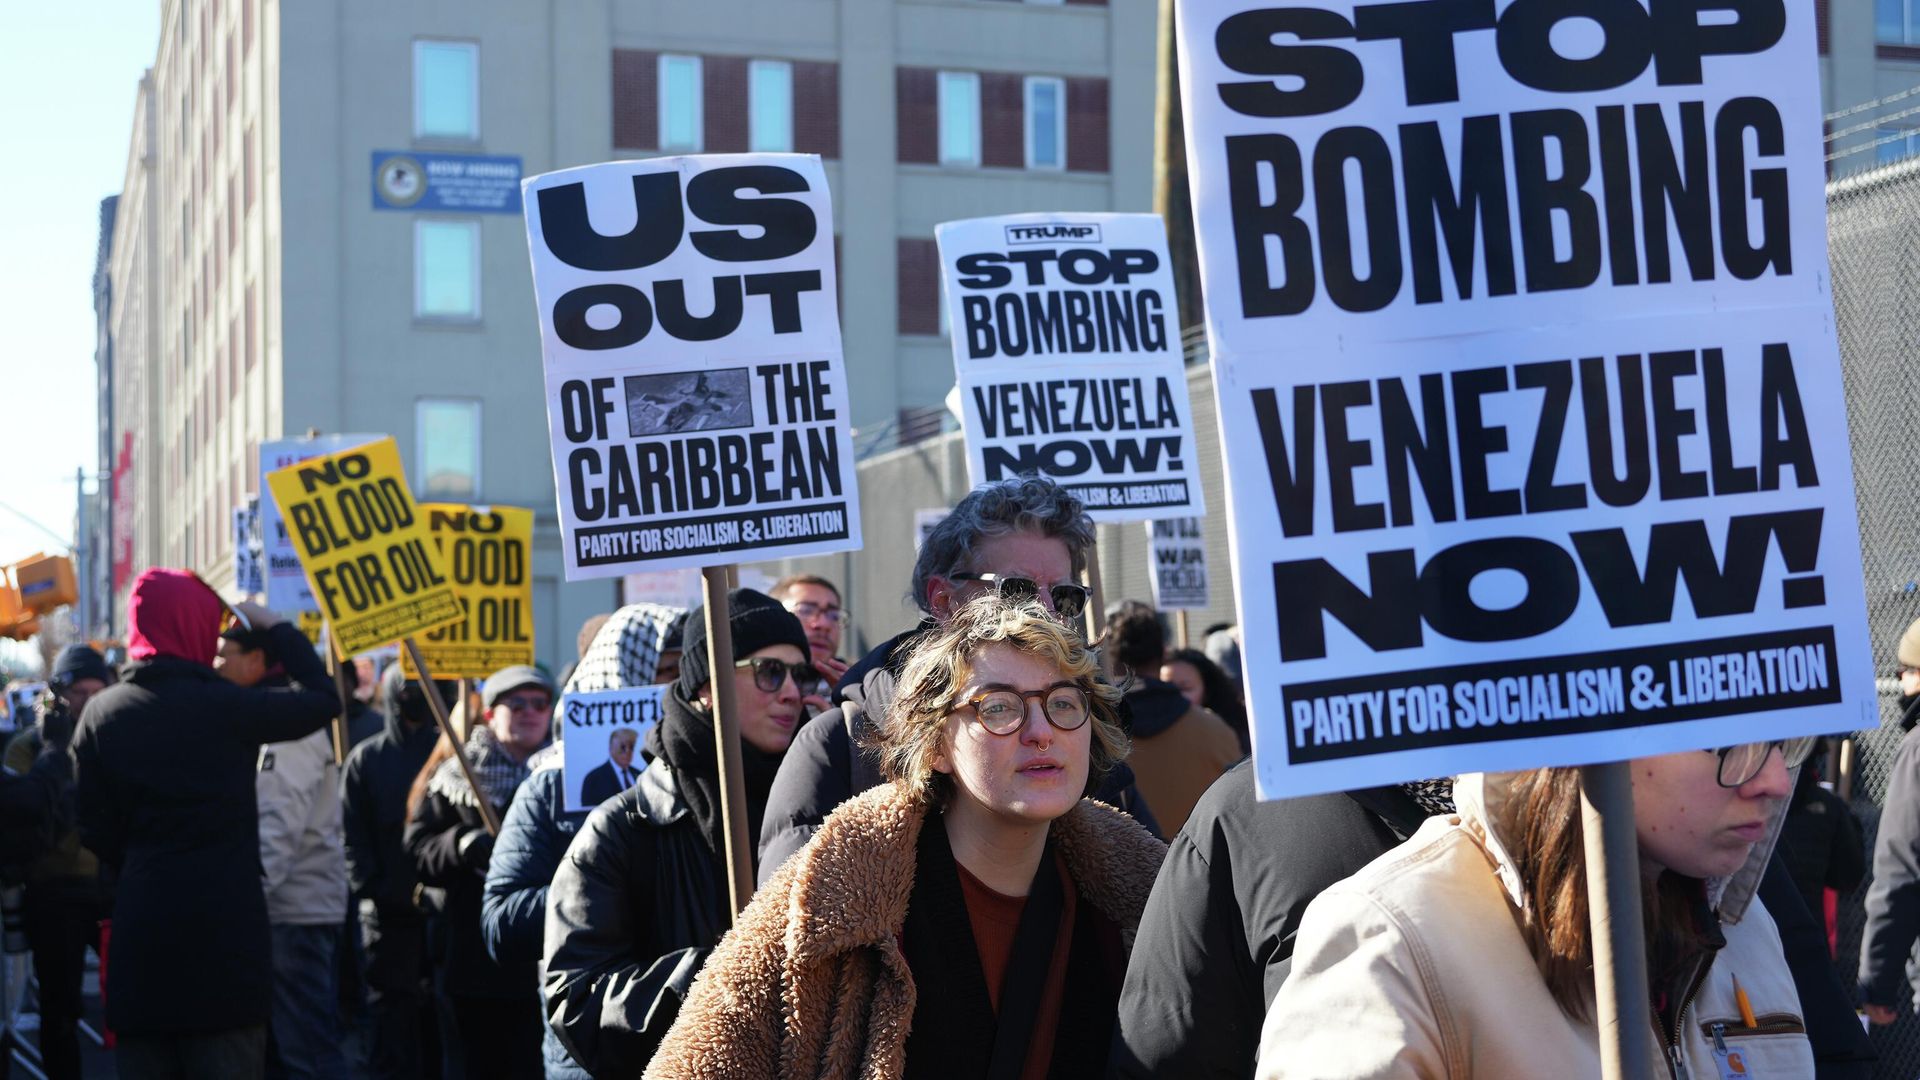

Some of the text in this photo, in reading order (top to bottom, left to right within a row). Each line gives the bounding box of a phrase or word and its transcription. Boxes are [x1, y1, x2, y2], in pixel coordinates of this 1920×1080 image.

[1215, 0, 1786, 119] STOP
[537, 165, 817, 271] US
[1010, 227, 1093, 239] TRUMP
[1225, 96, 1792, 319] BOMBING
[956, 249, 1159, 289] STOP
[553, 270, 822, 350] OUT
[962, 289, 1168, 359] BOMBING
[560, 360, 836, 443] OF THE
[972, 377, 1179, 438] VENEZUELA
[299, 454, 371, 493] NO
[568, 427, 842, 522] CARIBBEAN
[982, 436, 1184, 481] NOW!
[1251, 343, 1819, 538] VENEZUELA
[290, 478, 414, 558] BLOOD
[430, 510, 503, 533] NO
[1110, 487, 1124, 505] &
[1124, 483, 1187, 504] LIBERATION
[579, 510, 844, 559] PARTY FOR SOCIALISM & LIBERATION
[315, 553, 395, 620] FOR
[387, 539, 446, 594] OIL
[1272, 508, 1826, 663] NOW!
[479, 597, 528, 642] OIL
[567, 691, 664, 727] Terrori
[1292, 643, 1828, 748] PARTY FOR SOCIALISM & LIBERATION
